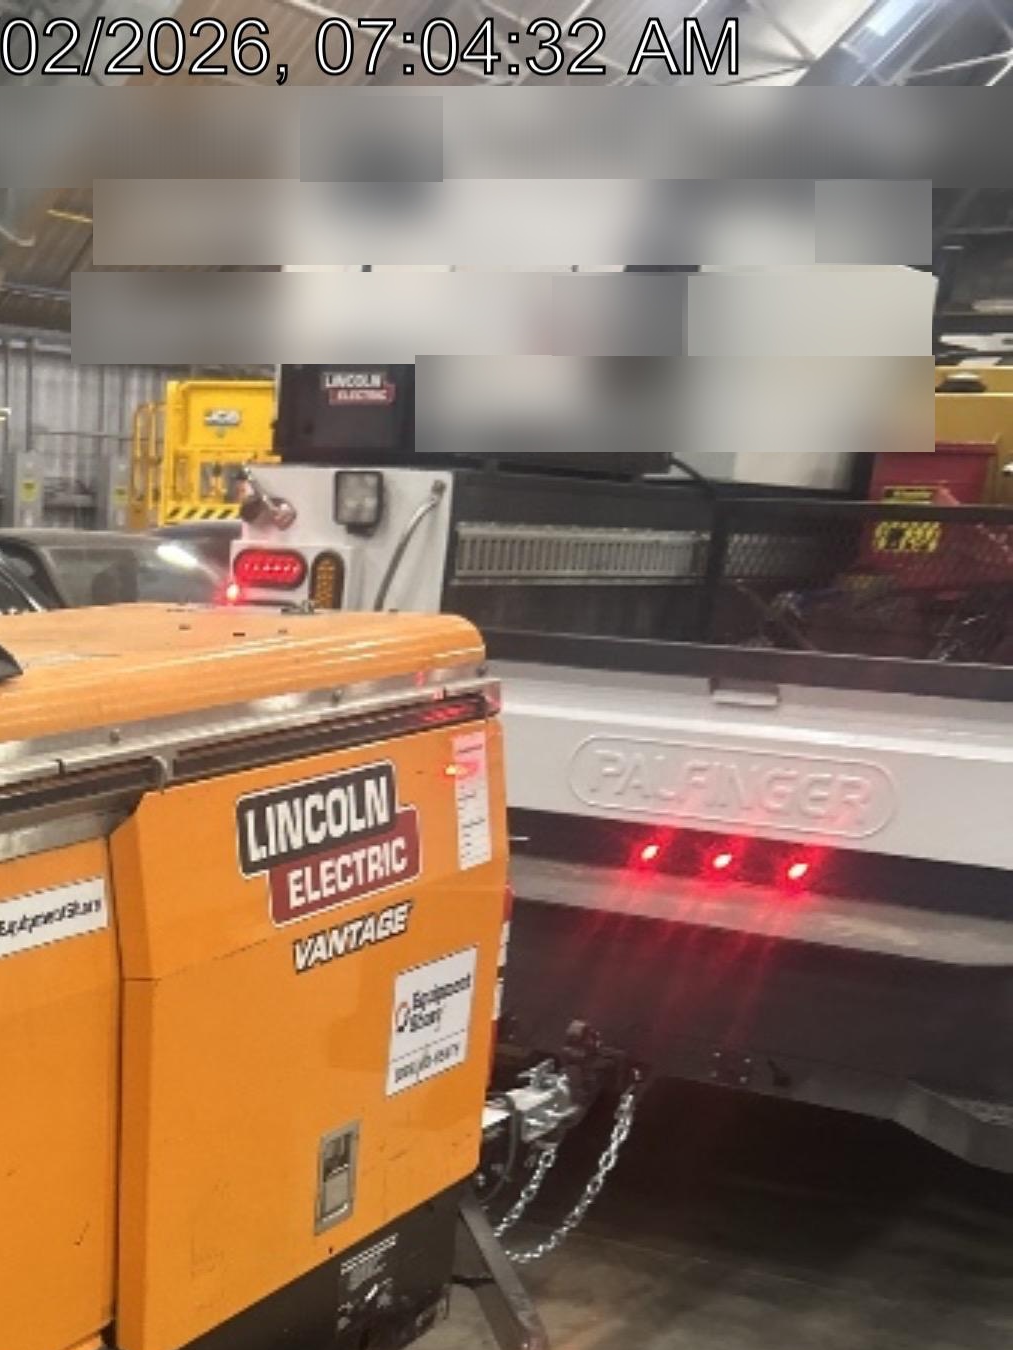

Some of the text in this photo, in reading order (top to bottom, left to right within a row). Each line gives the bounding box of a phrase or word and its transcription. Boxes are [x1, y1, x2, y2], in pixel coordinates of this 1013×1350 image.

[324, 373, 382, 389] LINCOLN
[245, 776, 390, 863] LINCOLN
[588, 749, 873, 827] PALFINGER
[287, 836, 408, 910] ELECTRIC
[292, 901, 413, 974] VANTAGE
